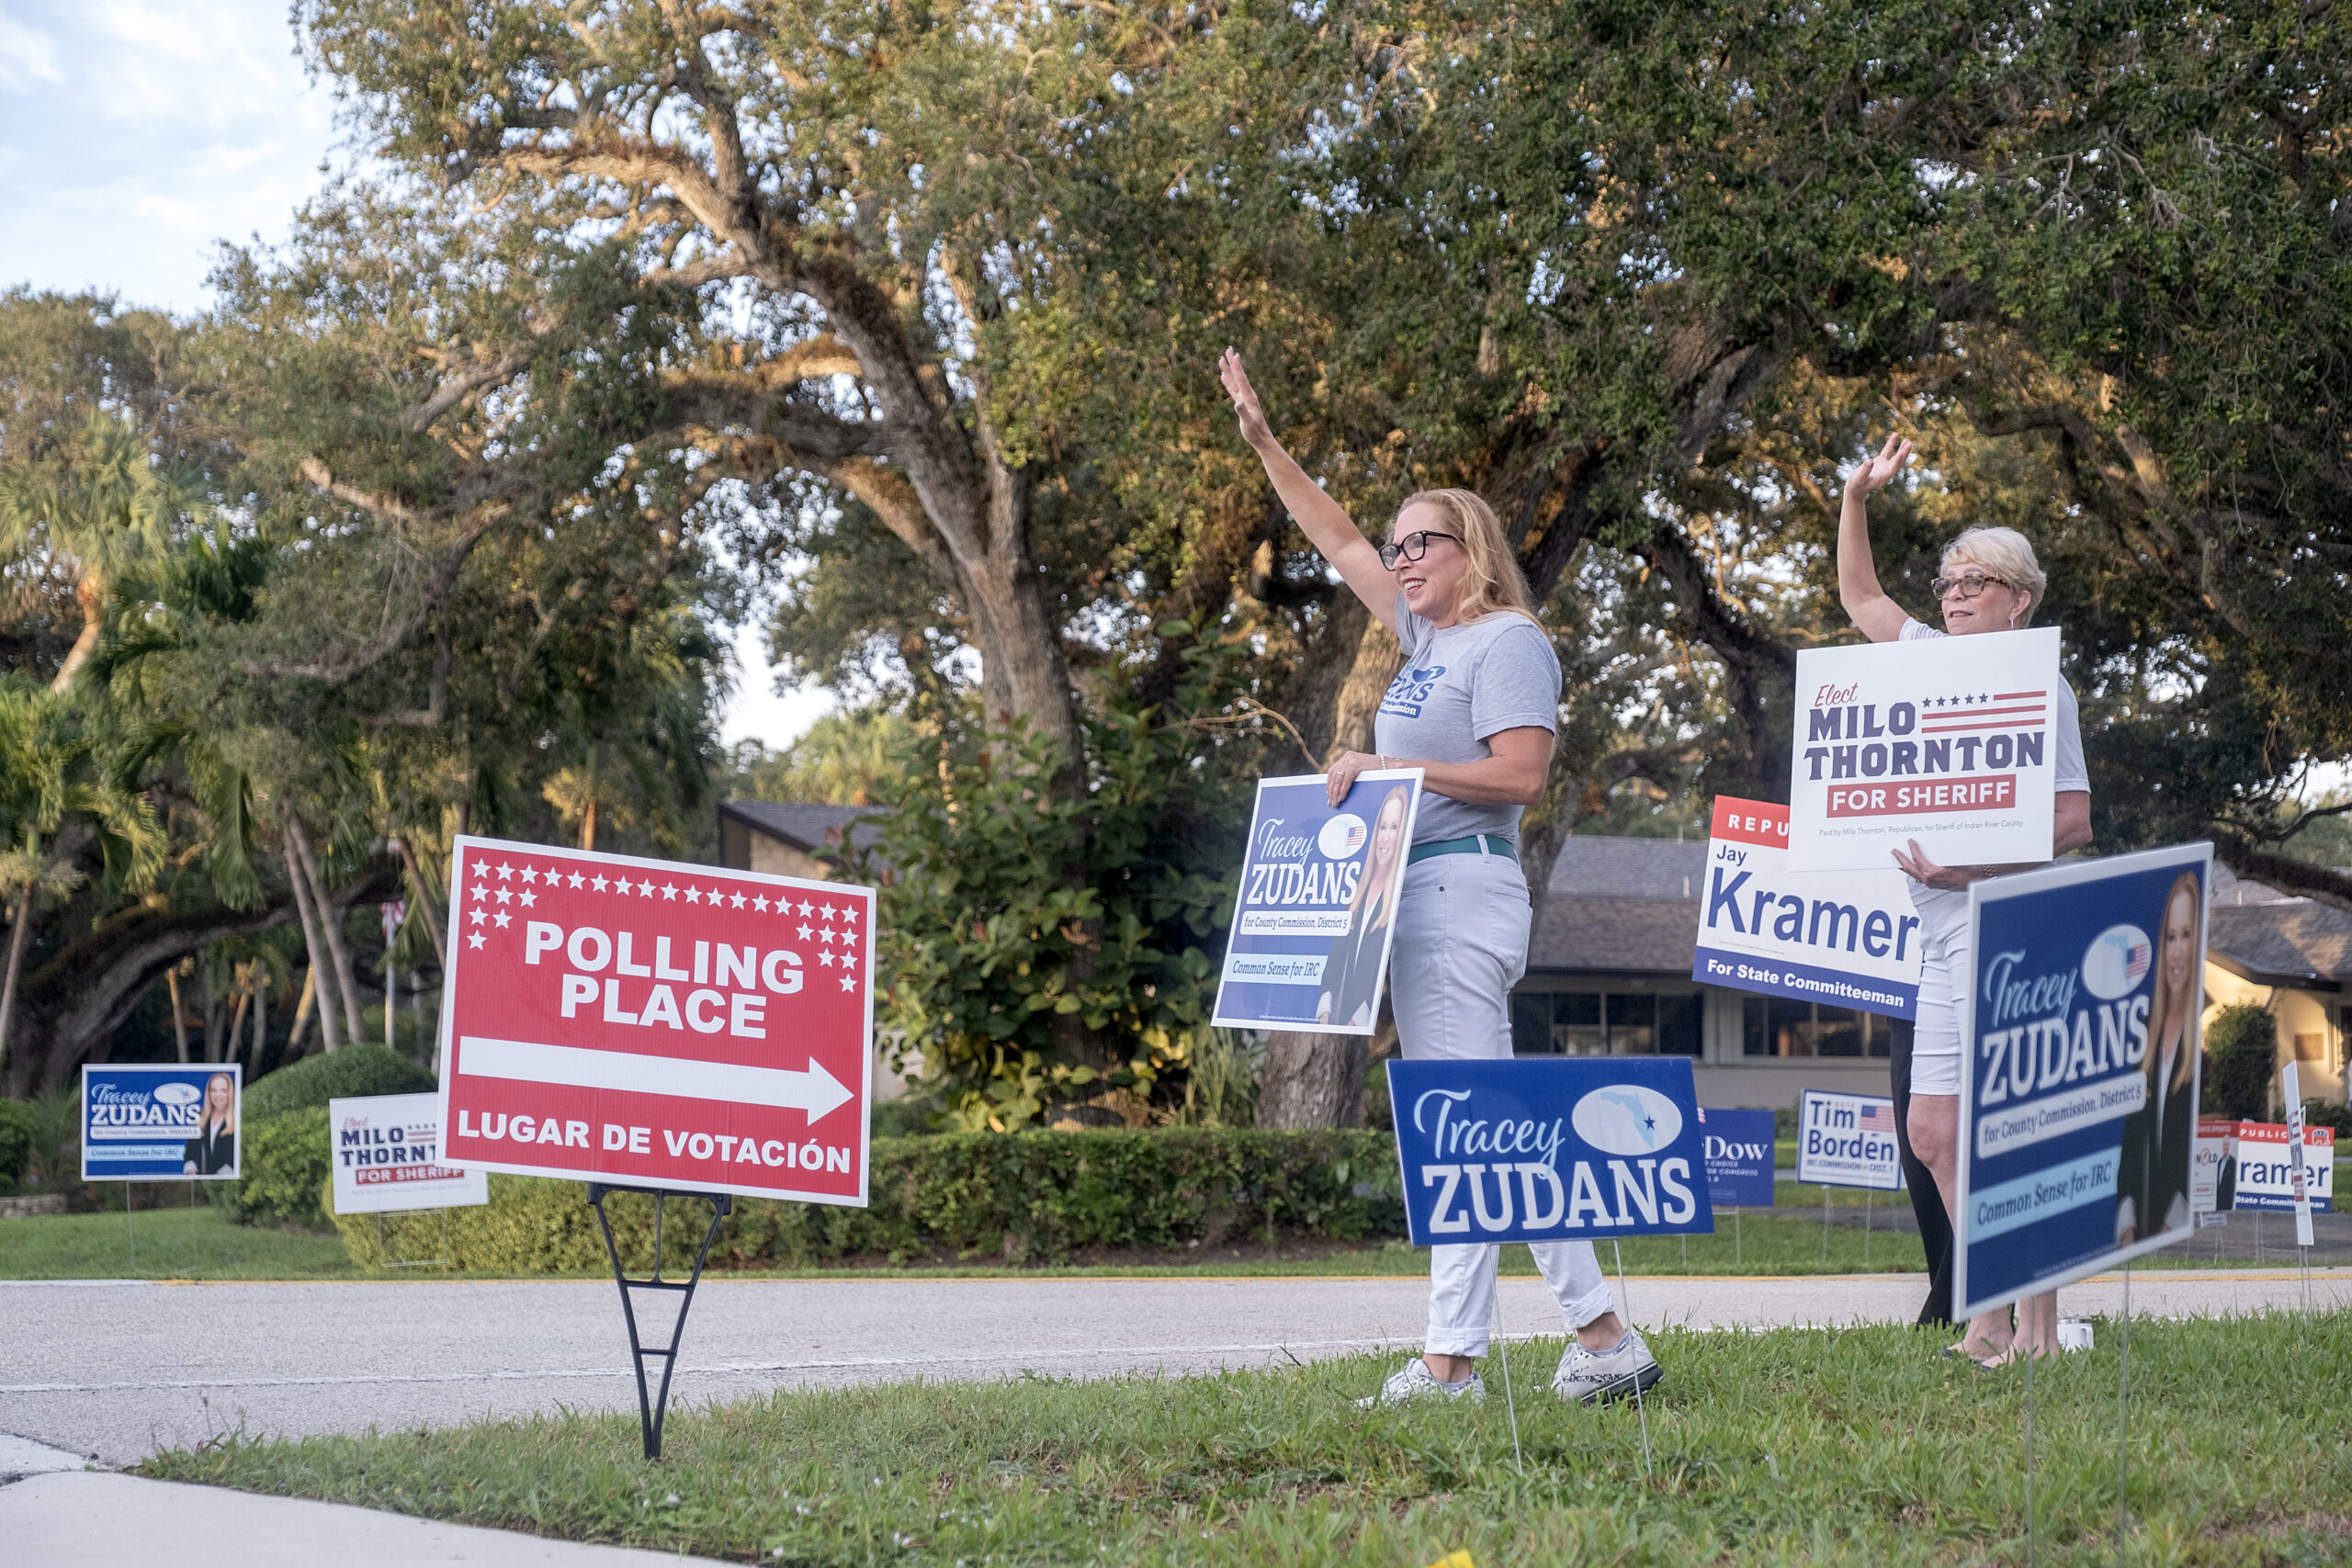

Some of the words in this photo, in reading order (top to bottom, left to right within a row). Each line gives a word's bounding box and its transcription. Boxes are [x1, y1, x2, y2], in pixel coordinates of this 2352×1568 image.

[1815, 682, 1859, 707] Elect
[1808, 701, 1916, 741] MILO
[1804, 731, 2045, 781] THORNTON
[1832, 788, 1886, 811] FOR
[1896, 781, 2011, 808] SHERIFF
[1728, 814, 1789, 837] REPU
[1819, 829, 1832, 837] Paid
[1833, 829, 1841, 837] by
[1925, 823, 1934, 831] for
[1935, 822, 1955, 831] Sheriff
[1956, 822, 1963, 830] of
[1964, 821, 1983, 830] Indian
[1984, 820, 1999, 829] River
[2000, 819, 2023, 828] County
[1258, 818, 1316, 874] Tracey
[1716, 844, 1747, 866] Jay
[1246, 861, 1362, 906] ZUDANS
[1244, 916, 1254, 928] for
[1255, 917, 1277, 931] County
[1278, 917, 1316, 930] Commission,
[1317, 917, 1342, 929] District
[1342, 919, 1348, 930] 5
[1707, 866, 1920, 962] Kramer
[525, 920, 804, 995] POLLING
[1232, 960, 1267, 975] Common
[1267, 961, 1289, 976] Sense
[1289, 963, 1304, 980] for
[1304, 963, 1320, 976] IRC
[1707, 958, 1734, 976] For
[1736, 964, 1780, 985] State
[1783, 972, 1905, 1008] Committeeman
[1983, 948, 2078, 1035] Tracey
[560, 974, 767, 1040] PLACE
[1980, 995, 2150, 1108] ZUDANS
[91, 1083, 152, 1107] Tracey
[91, 1103, 201, 1126] ZUDANS
[1810, 1100, 1854, 1130] Tim
[1984, 1125, 2000, 1145] for
[2001, 1115, 2038, 1138] County
[2100, 1089, 2135, 1110] District
[2135, 1084, 2143, 1100] 5
[340, 1127, 404, 1146] MILO
[458, 1110, 590, 1148] LUGAR
[602, 1123, 651, 1154] DE
[662, 1130, 851, 1174] VOTACIÓN
[1414, 1089, 1566, 1179] Tracey
[1702, 1134, 1769, 1161] Dow
[1808, 1130, 1894, 1162] Borden
[357, 1169, 392, 1184] FOR
[396, 1167, 461, 1181] SHERIFF
[1421, 1156, 1696, 1234] ZUDANS
[1977, 1191, 2032, 1226] Common
[2034, 1181, 2068, 1207] Sense
[2069, 1171, 2089, 1201] for
[2091, 1160, 2113, 1188] IRC
